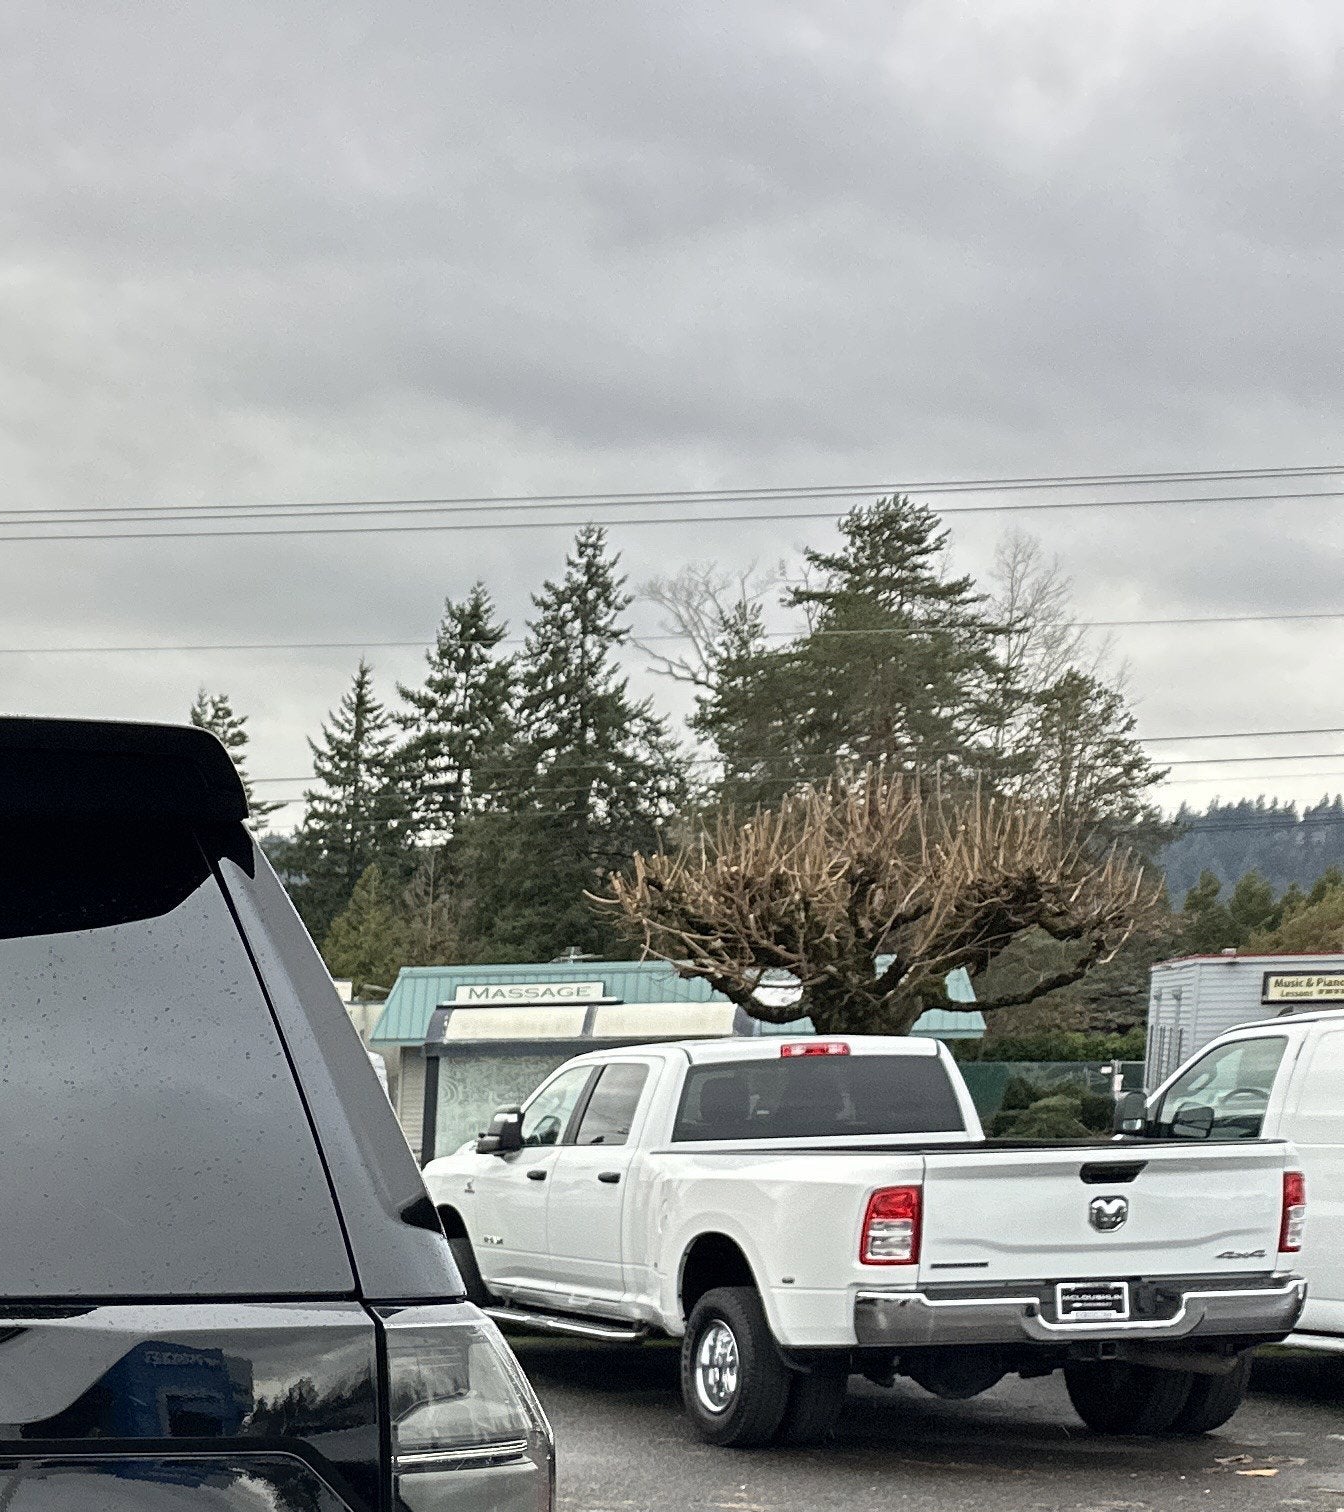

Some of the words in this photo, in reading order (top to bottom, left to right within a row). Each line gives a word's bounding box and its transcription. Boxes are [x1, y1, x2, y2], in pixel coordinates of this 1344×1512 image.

[1274, 978, 1303, 987] Music
[1306, 977, 1313, 987] &
[468, 985, 592, 1000] MASSAGE
